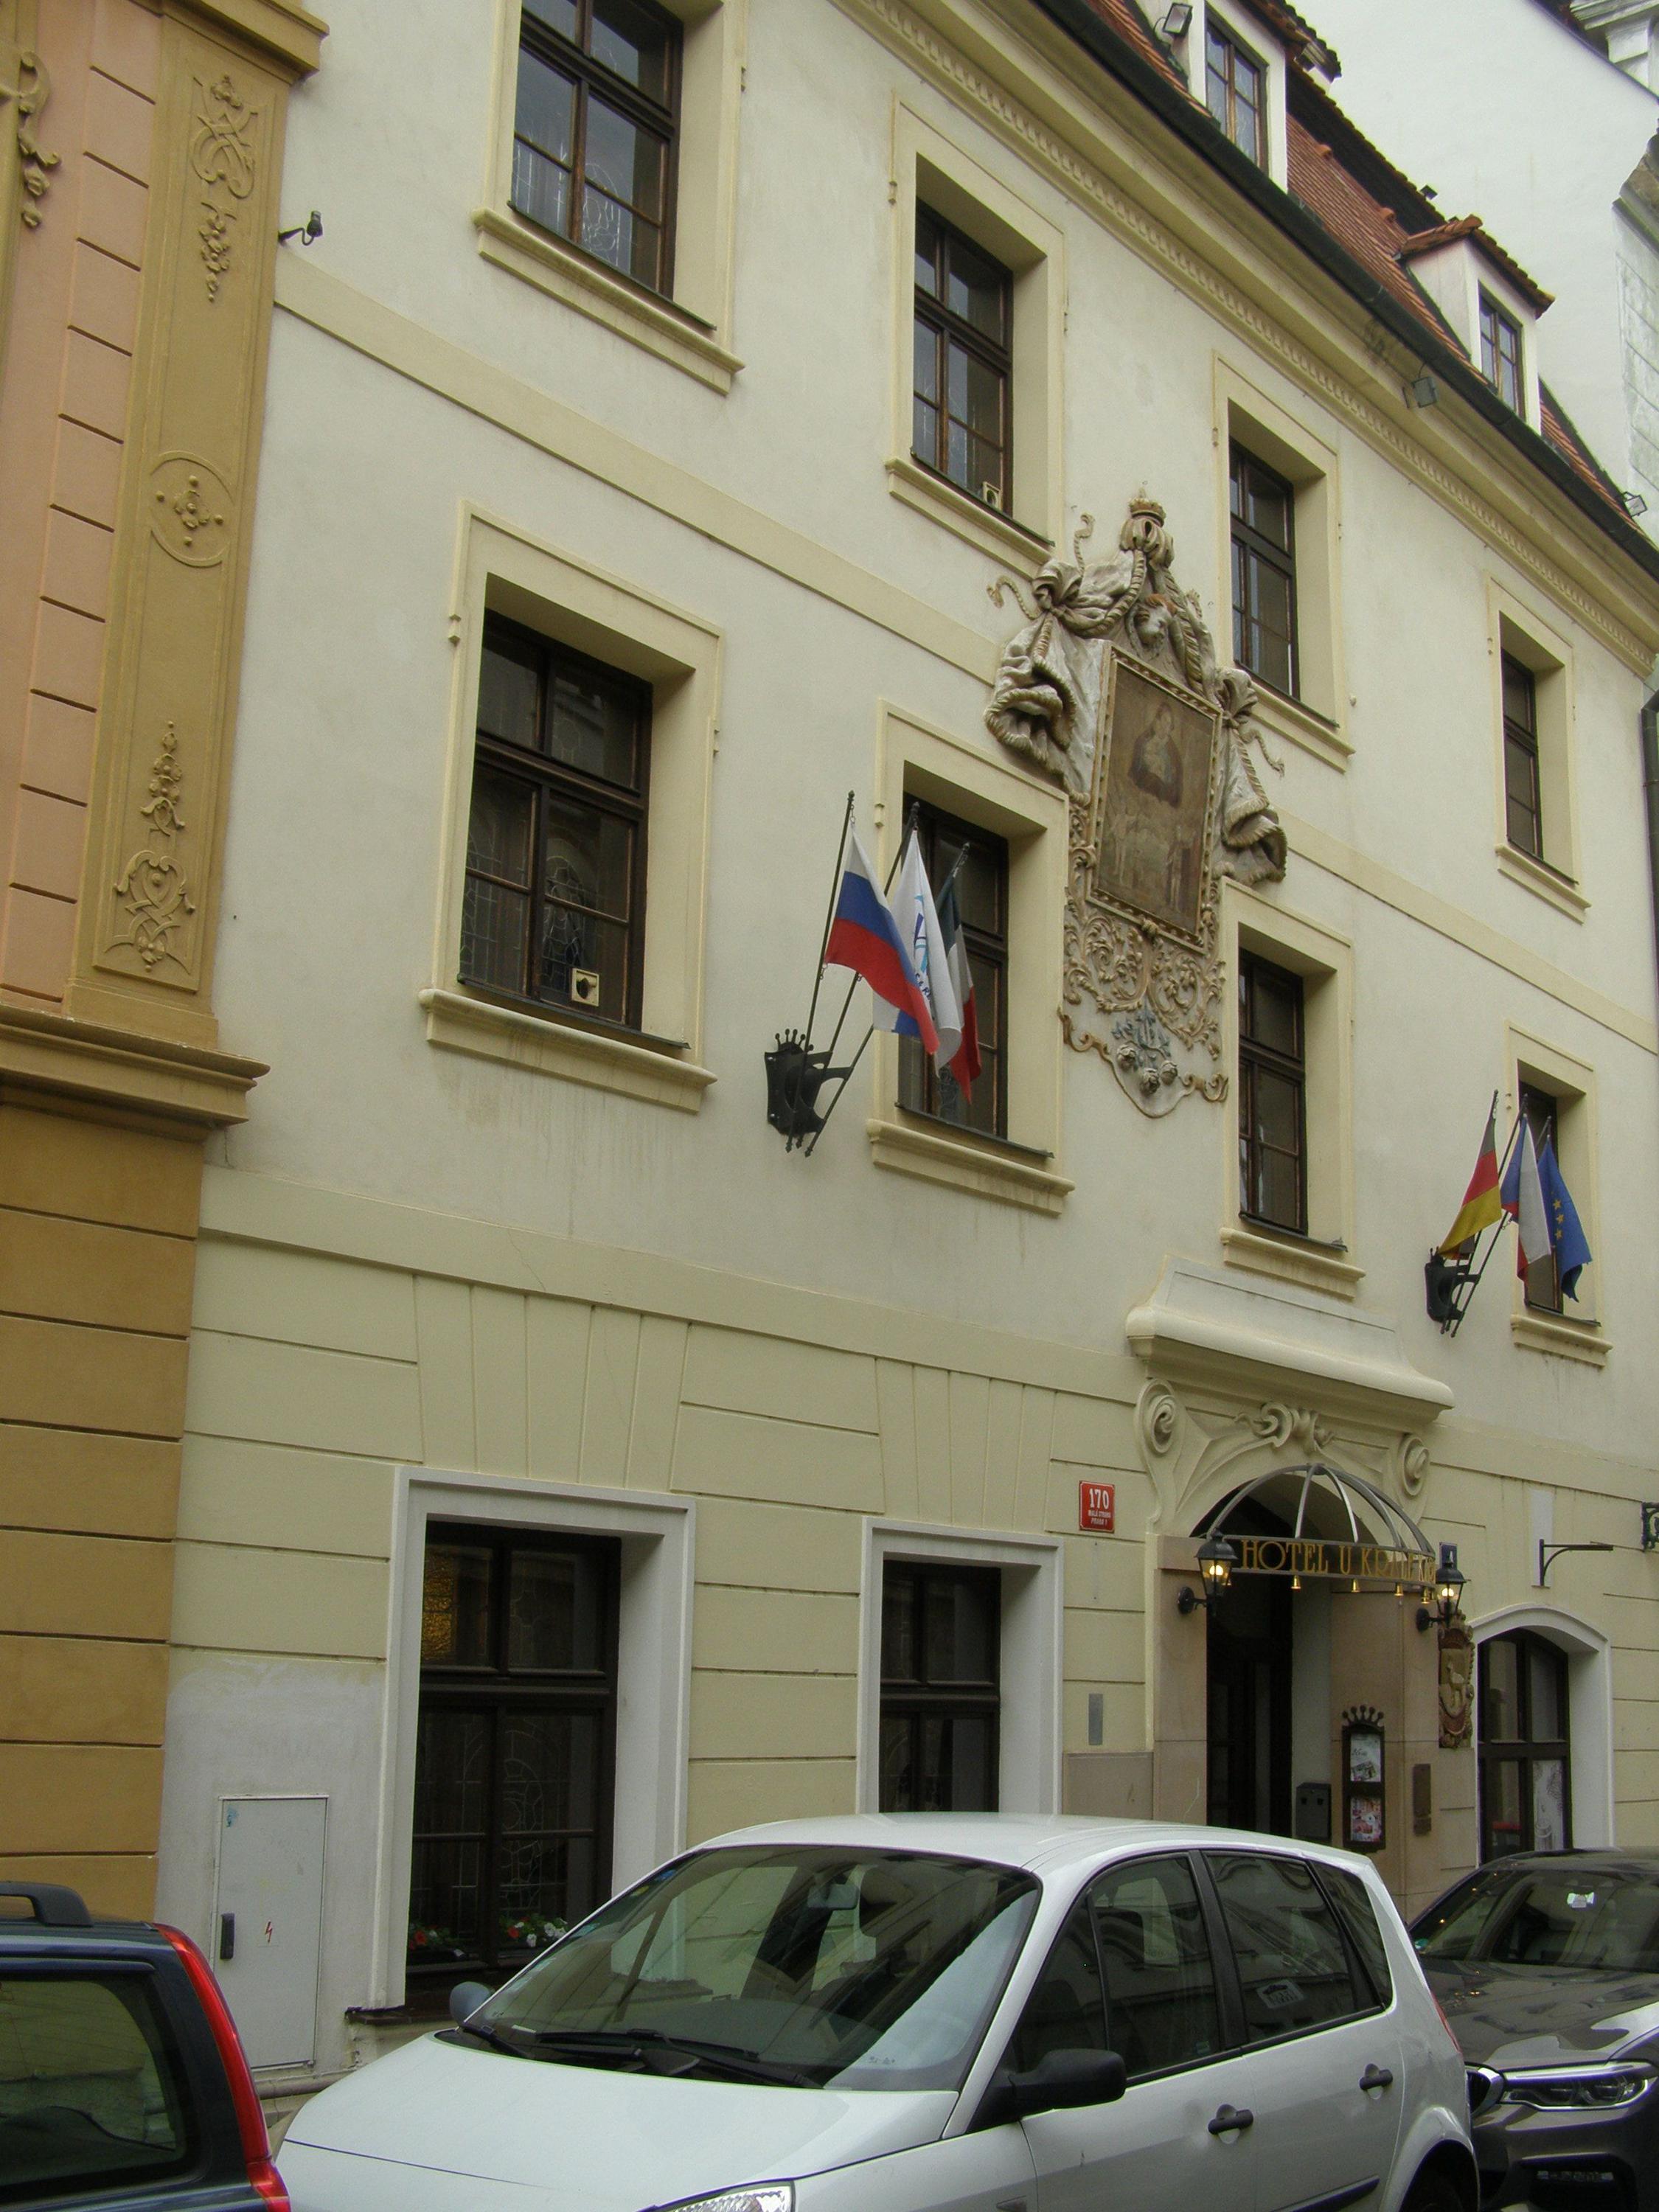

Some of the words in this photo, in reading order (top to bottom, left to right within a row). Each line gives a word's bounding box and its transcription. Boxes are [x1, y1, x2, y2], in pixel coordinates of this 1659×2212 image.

[1089, 1488, 1110, 1509] 170
[1241, 1538, 1328, 1573] HOTEL
[1339, 1545, 1352, 1576] U
